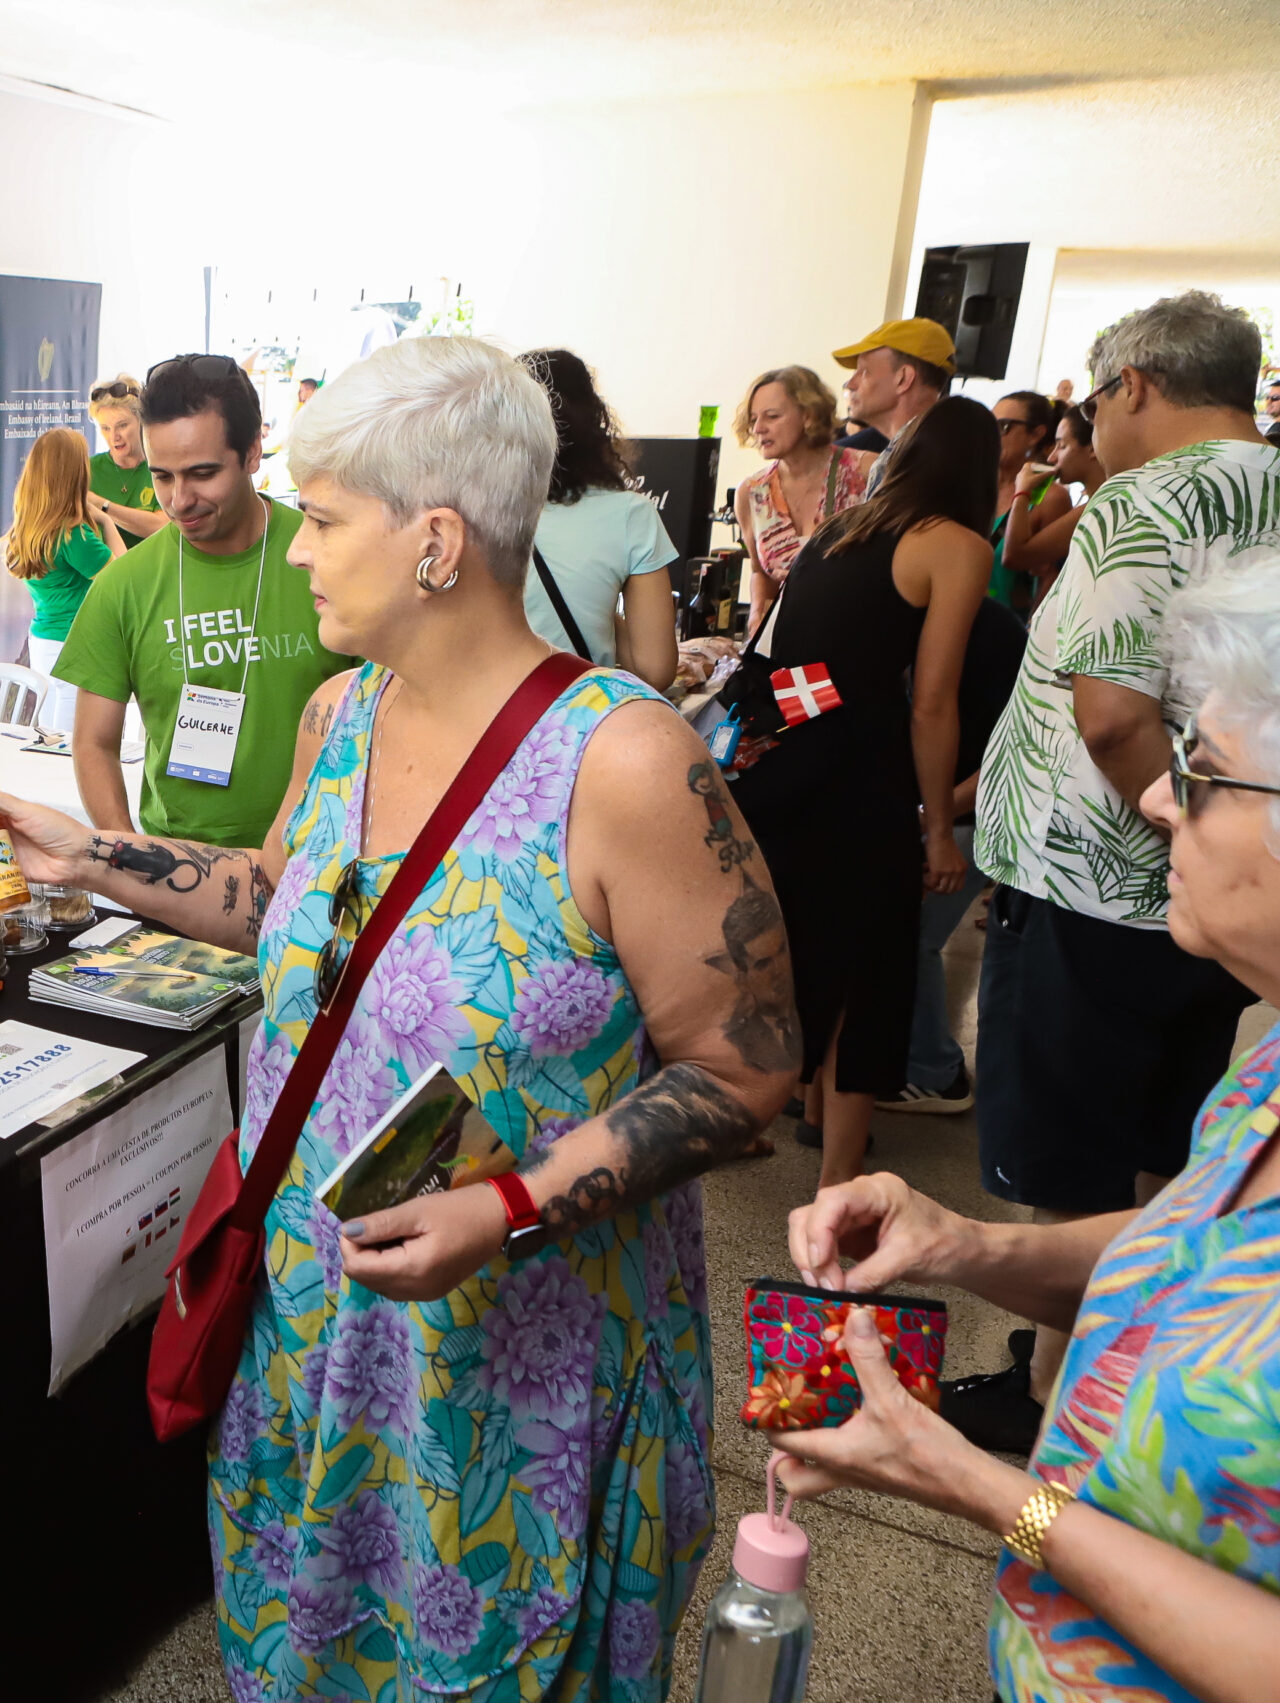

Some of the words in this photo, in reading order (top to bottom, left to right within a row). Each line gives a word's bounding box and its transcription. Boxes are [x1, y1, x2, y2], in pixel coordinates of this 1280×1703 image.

[0, 400, 24, 411] mbasáid
[8, 414, 33, 426] Embassy
[35, 413, 42, 424] of
[164, 619, 177, 643] I
[183, 608, 252, 640] FEEL
[170, 632, 315, 672] SLOVENIA
[65, 1163, 100, 1192] CONCORRA
[120, 1137, 140, 1157] CESTA
[141, 1131, 150, 1142] DE
[150, 1109, 182, 1136] PRODUTOS
[182, 1089, 214, 1116] EUROPEUS
[80, 1210, 109, 1233] COMPRA
[108, 1198, 123, 1215] POR
[122, 1183, 146, 1207] PESSOA
[155, 1158, 180, 1181] COUPON
[180, 1148, 193, 1164] POR
[192, 1136, 213, 1156] PESSOA
